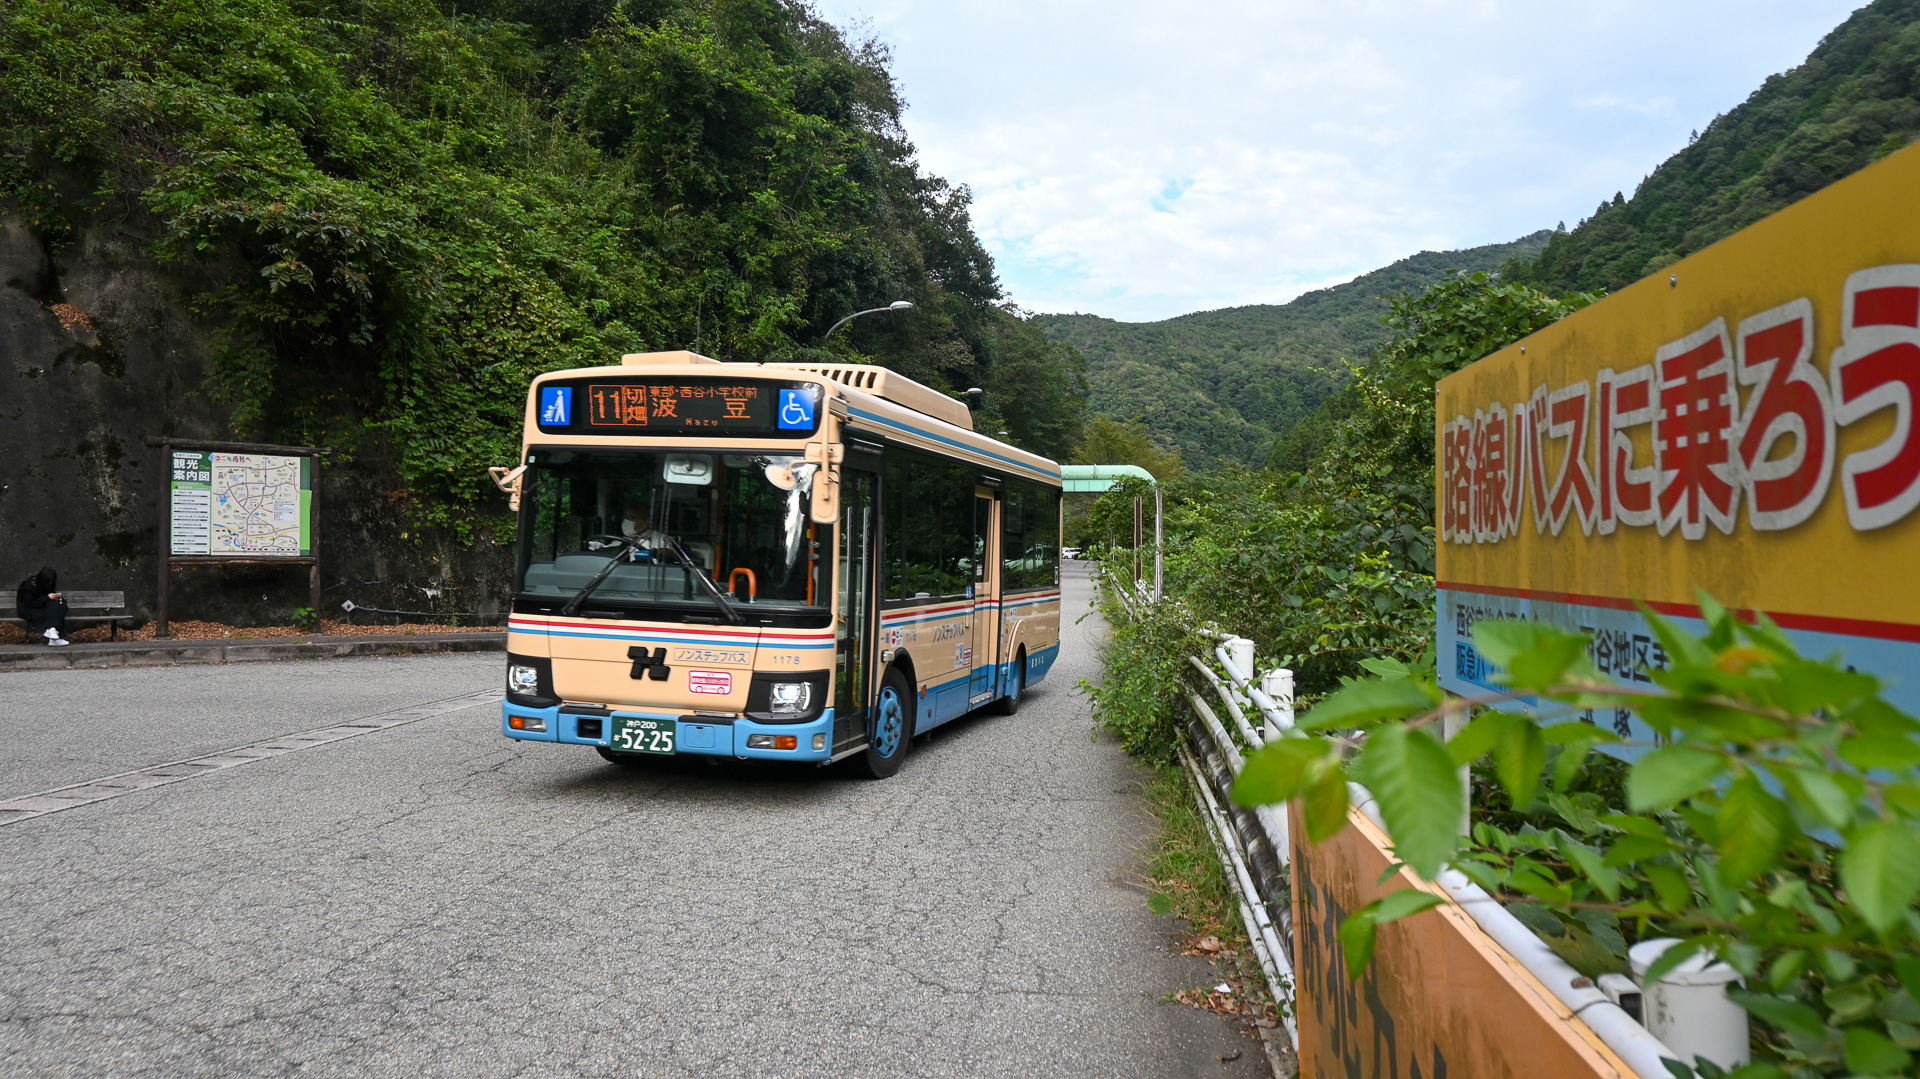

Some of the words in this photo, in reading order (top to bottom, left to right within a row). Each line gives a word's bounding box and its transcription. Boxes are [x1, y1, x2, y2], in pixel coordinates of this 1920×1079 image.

[594, 390, 620, 418] 11
[652, 397, 751, 418] 波豆
[1443, 264, 1920, 544] 路線バスに乗ろう
[173, 458, 198, 470] 観光
[173, 469, 210, 482] 案内図
[678, 650, 747, 663] ノンステップバス
[773, 655, 801, 665] 1178
[626, 720, 658, 730] 神戸200
[621, 728, 674, 752] 52-25
